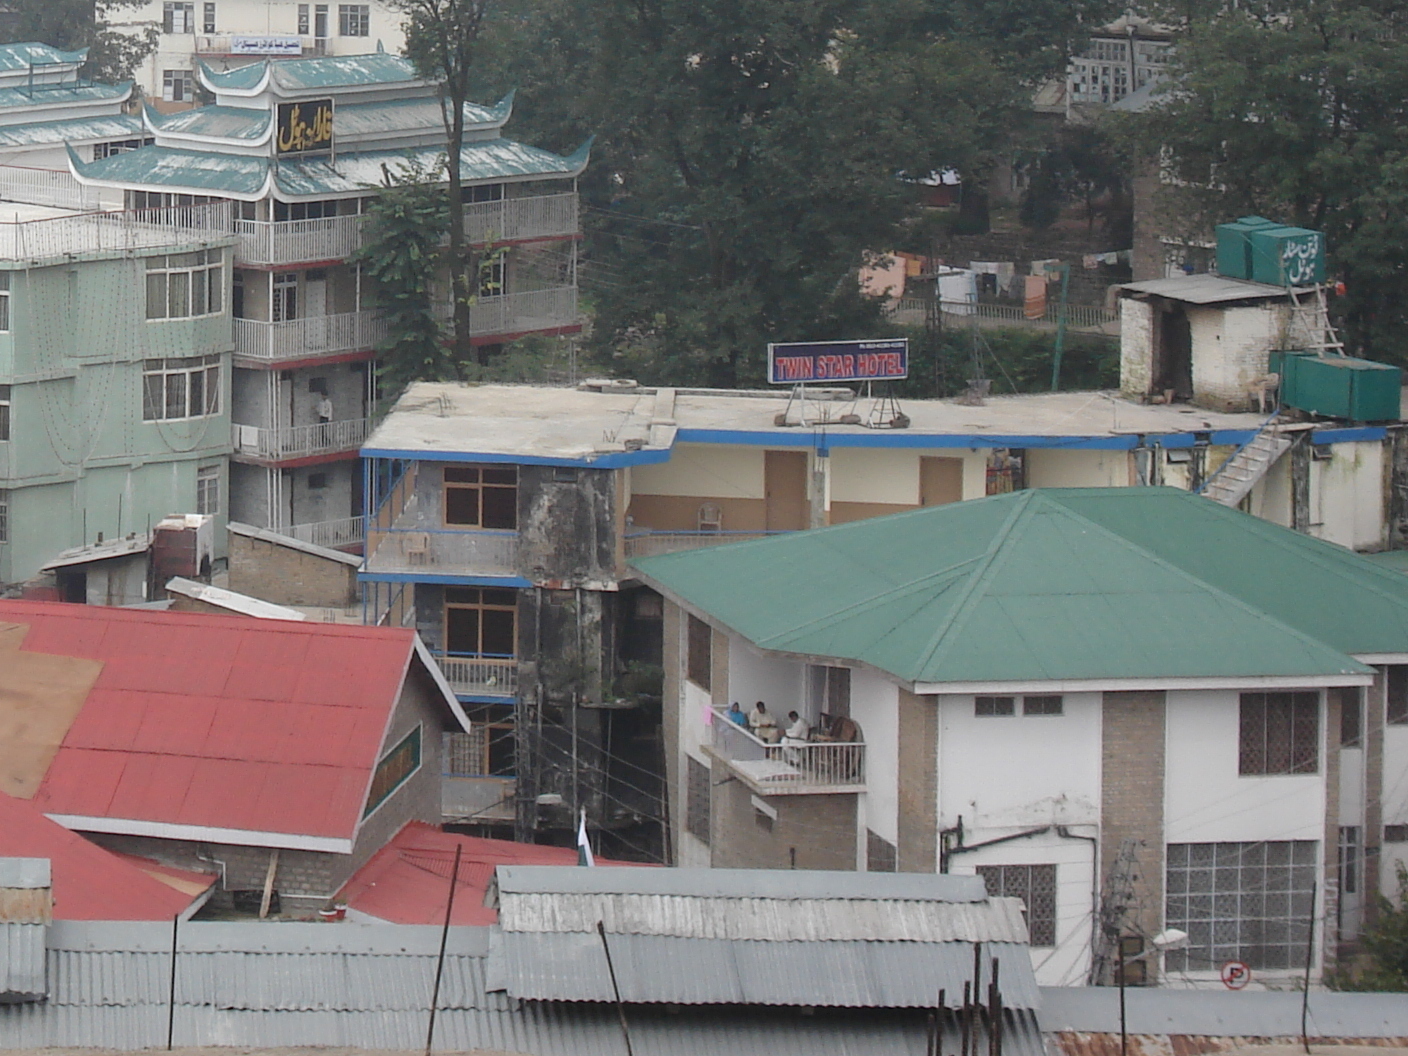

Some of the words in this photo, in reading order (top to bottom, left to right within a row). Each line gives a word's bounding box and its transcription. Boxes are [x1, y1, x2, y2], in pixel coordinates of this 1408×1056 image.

[776, 356, 813, 379] TWIN
[817, 354, 854, 378] STAR
[857, 352, 904, 375] HOTEL
